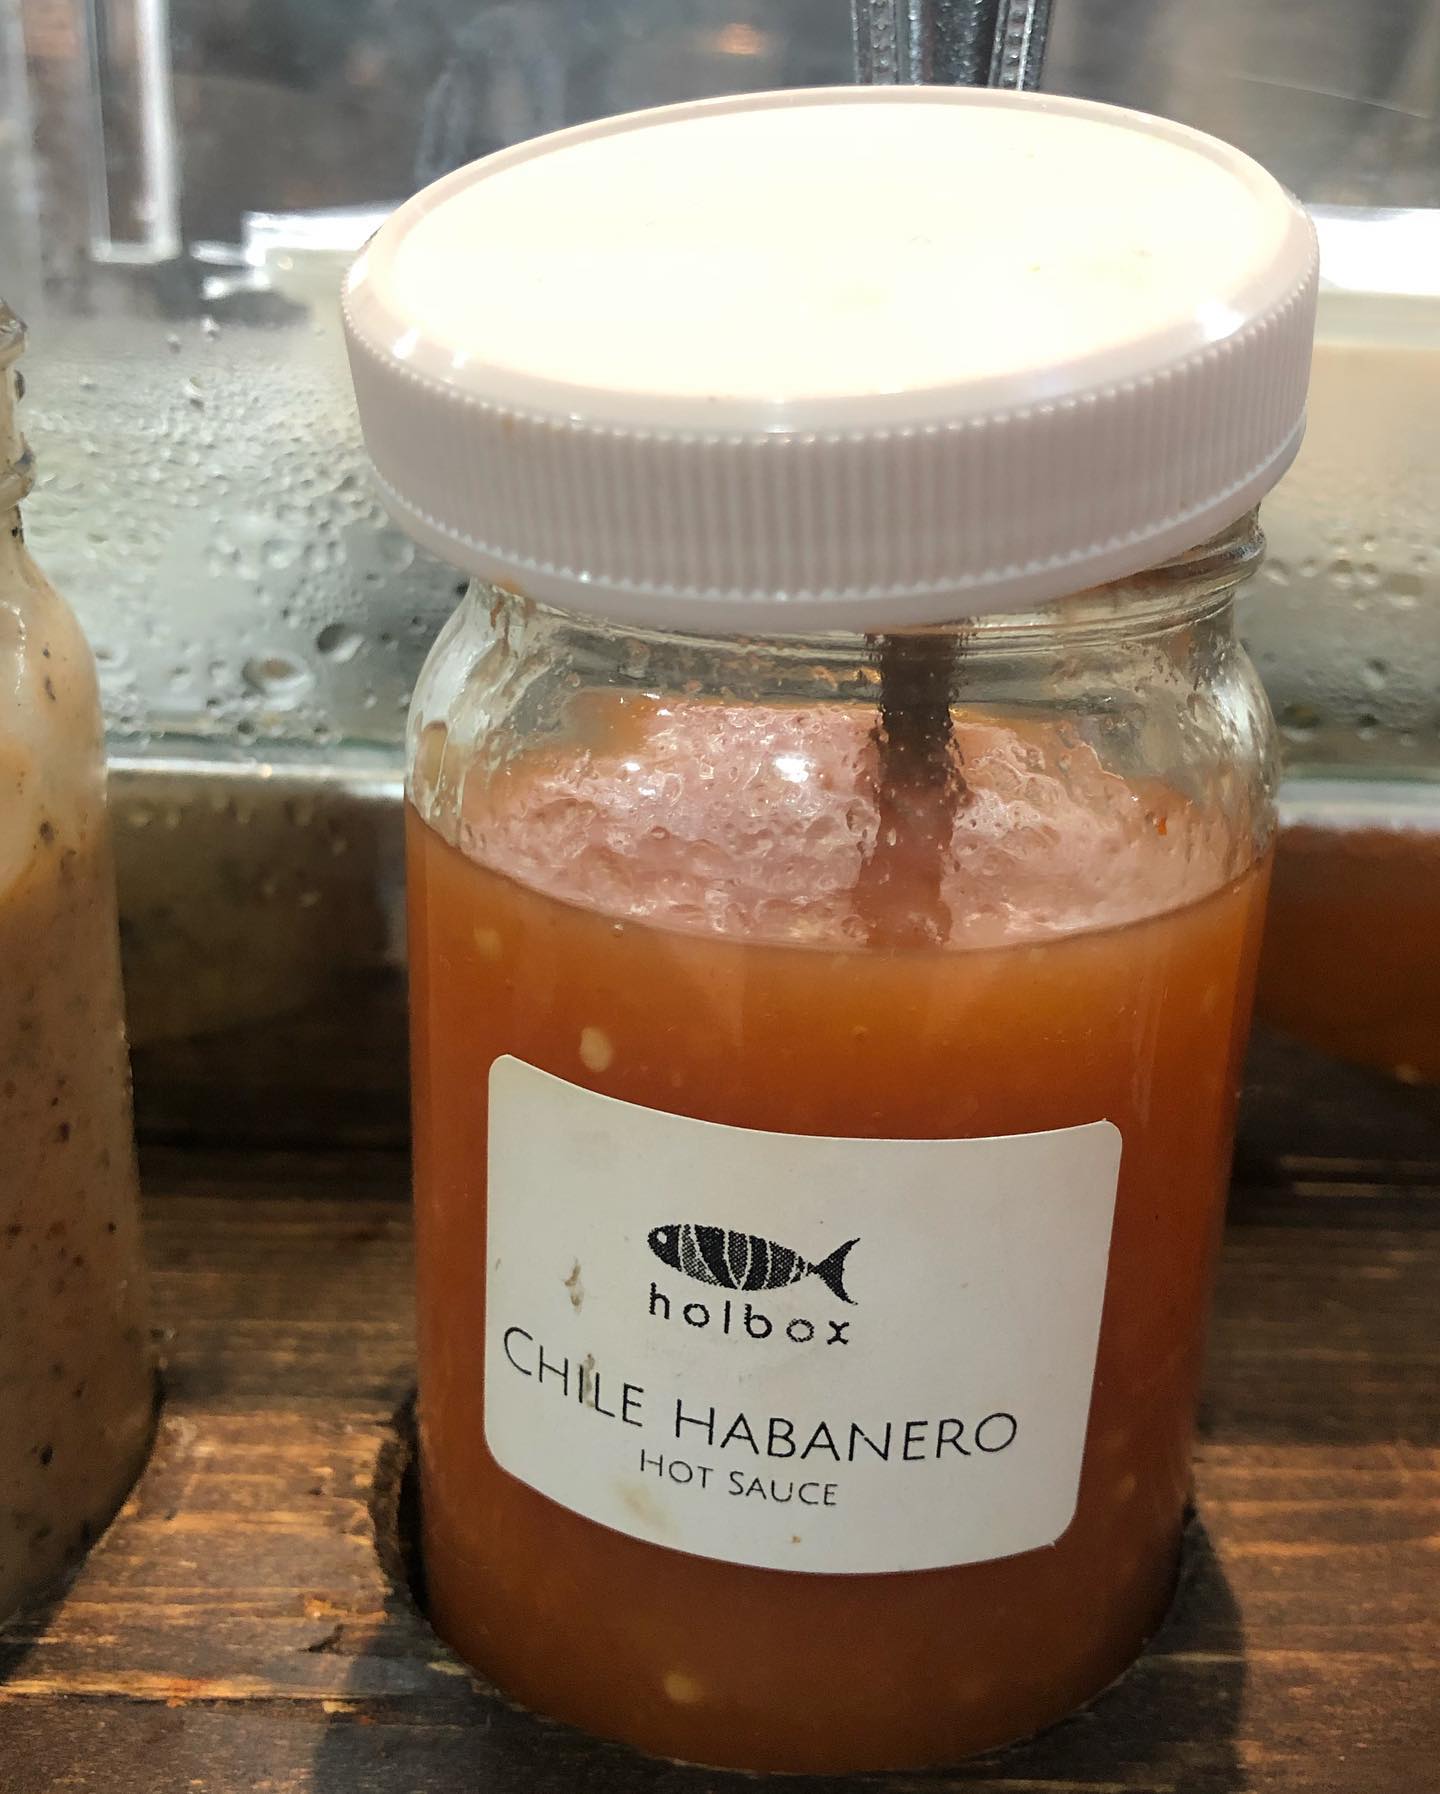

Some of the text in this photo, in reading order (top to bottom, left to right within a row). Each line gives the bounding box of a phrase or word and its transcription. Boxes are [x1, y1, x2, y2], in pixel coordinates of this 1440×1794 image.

[648, 1282, 851, 1346] holbox
[503, 1326, 1018, 1463] CHILE HABANERO
[640, 1447, 839, 1506] HOT SAUCE
